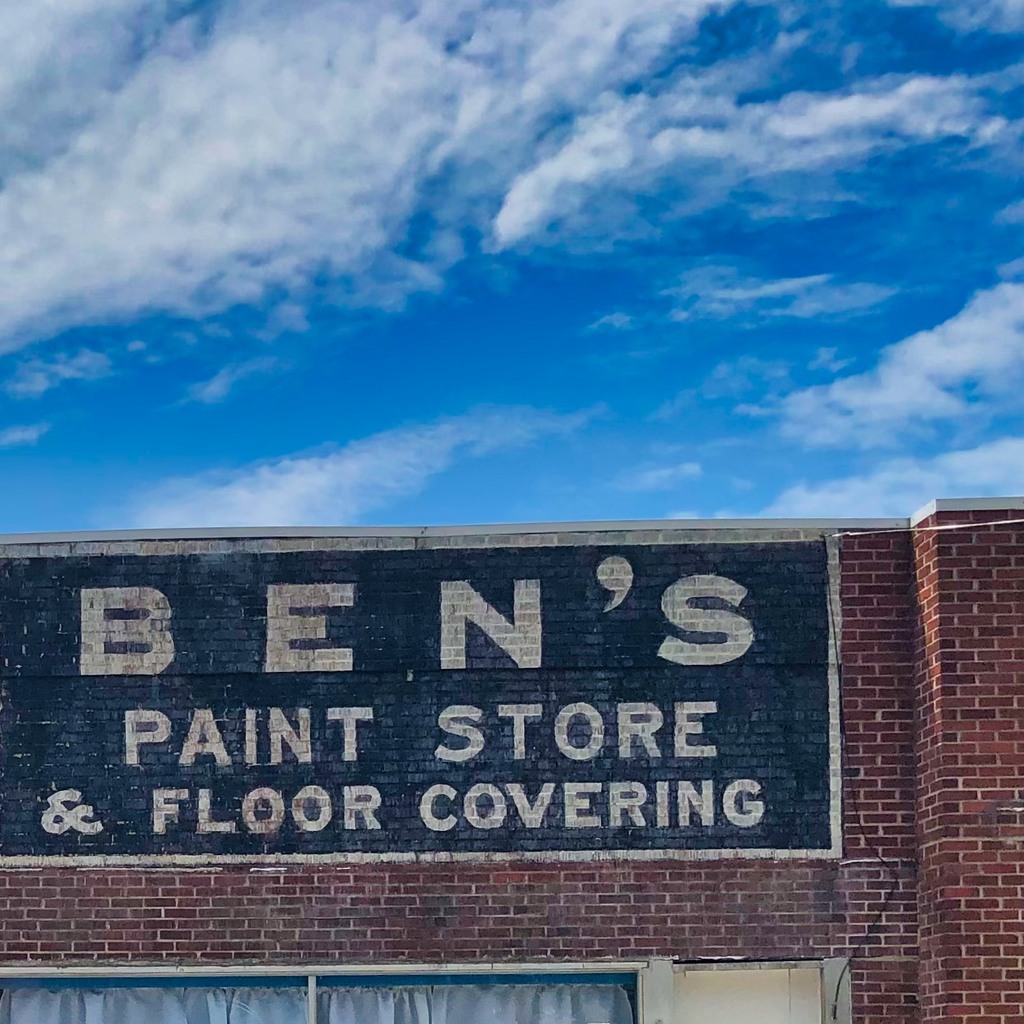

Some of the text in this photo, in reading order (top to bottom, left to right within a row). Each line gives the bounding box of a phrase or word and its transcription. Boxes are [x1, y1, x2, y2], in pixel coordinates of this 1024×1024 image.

[80, 555, 756, 675] BEN'S
[125, 701, 718, 766] PAINT STORE
[40, 778, 765, 835] & FLOOR COVERING
